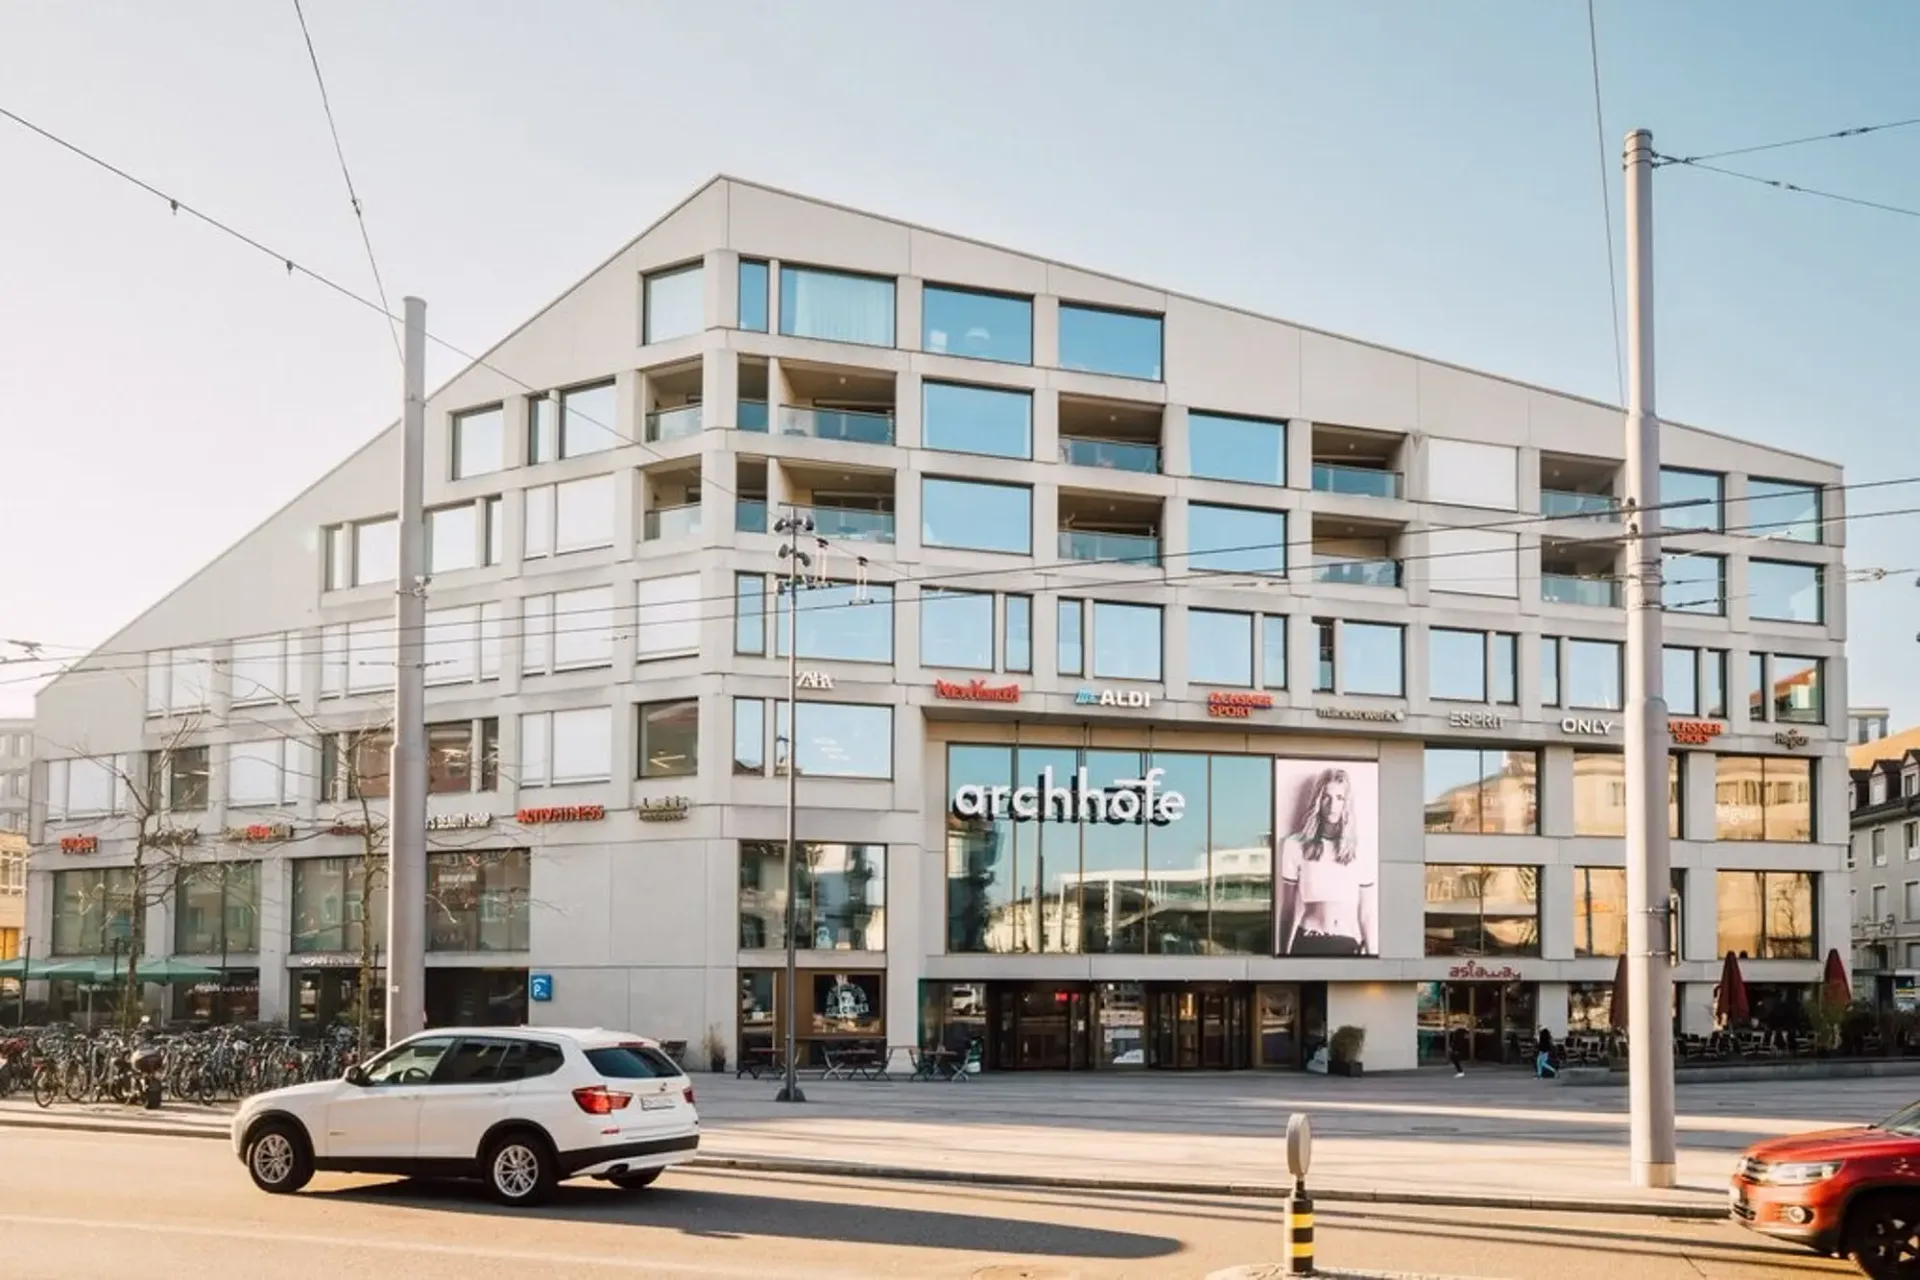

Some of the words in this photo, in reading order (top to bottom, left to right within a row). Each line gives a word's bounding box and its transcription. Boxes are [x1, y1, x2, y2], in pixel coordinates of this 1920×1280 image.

[1100, 689, 1151, 708] ALDI
[1208, 705, 1249, 718] SPORT
[1449, 711, 1503, 729] ESPRIT
[1561, 717, 1612, 734] ONLY
